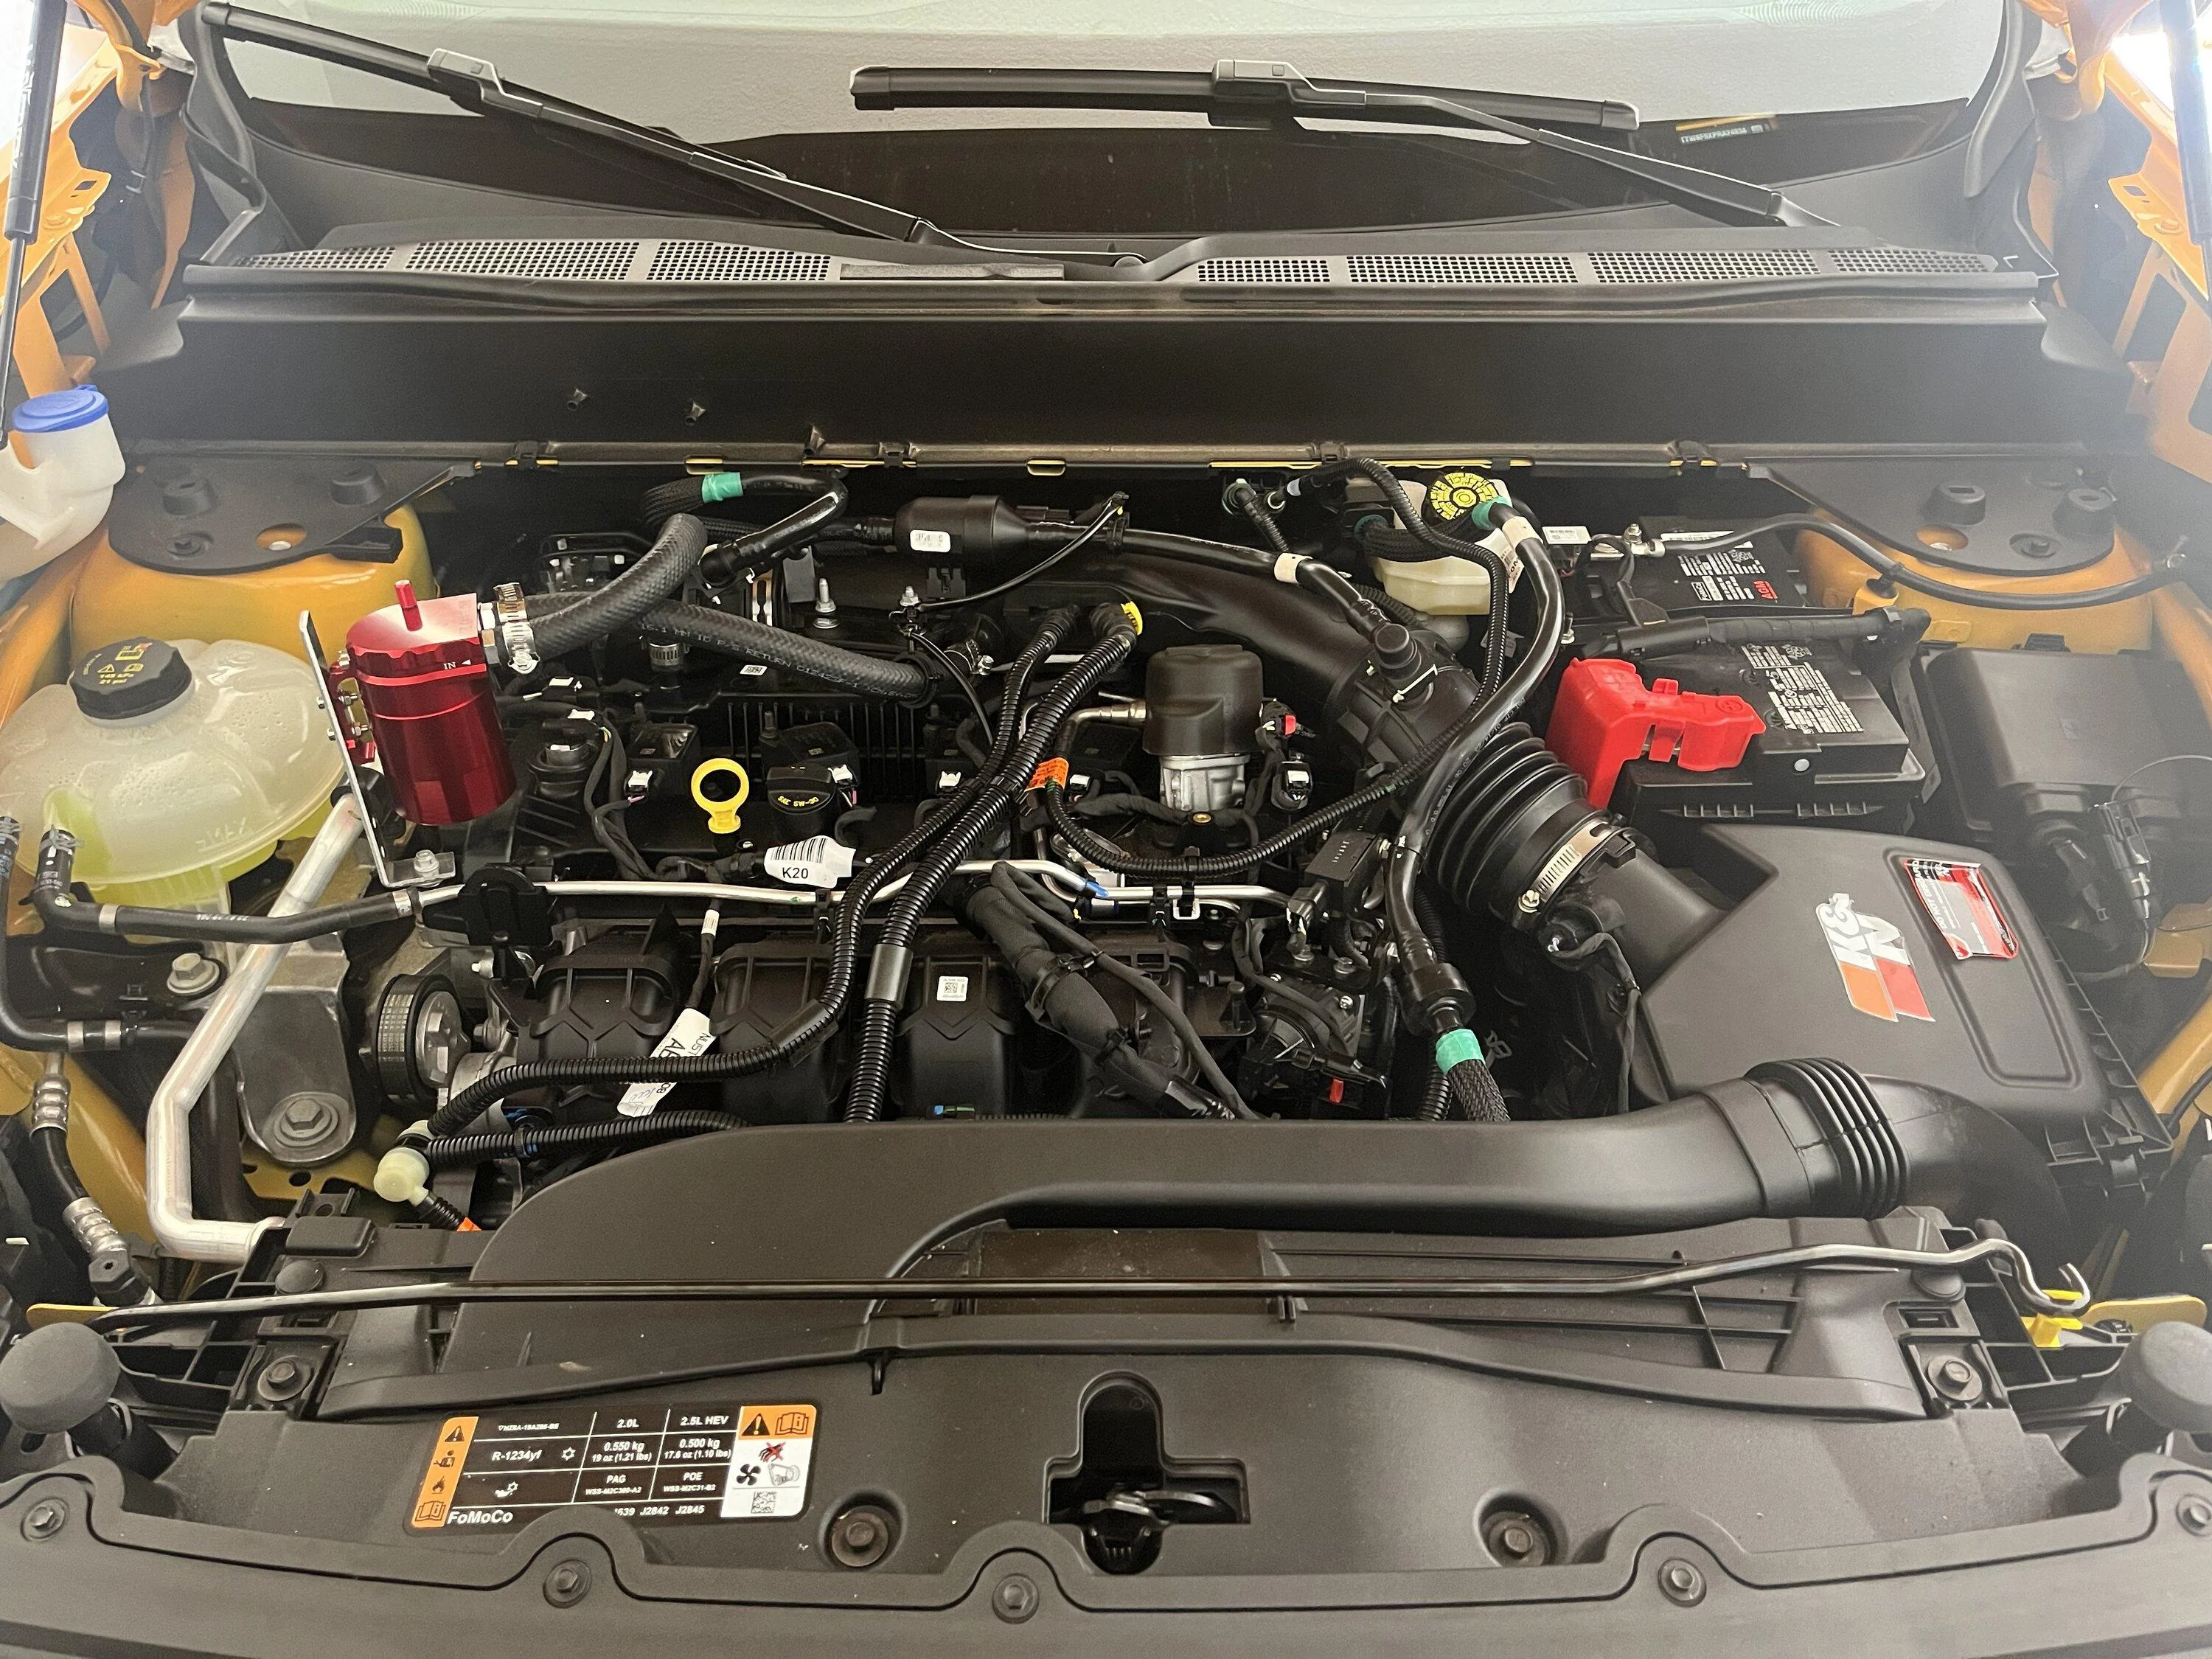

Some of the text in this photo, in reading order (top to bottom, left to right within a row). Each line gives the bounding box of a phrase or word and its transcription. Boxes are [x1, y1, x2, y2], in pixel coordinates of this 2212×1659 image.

[443, 661, 456, 670] IN
[782, 867, 808, 879] K20
[617, 1419, 639, 1429] 2.0L
[680, 1416, 729, 1426] 2.5L HEV
[604, 1441, 645, 1453] 0.550 kg
[679, 1438, 721, 1450] 0.500 kg
[492, 1449, 543, 1462] R-1234yf
[592, 1453, 602, 1462] 19
[614, 1453, 635, 1463] (1.21
[636, 1452, 653, 1462] lbs)
[664, 1449, 731, 1460] 17.6 oz (1.10 lbs)
[606, 1475, 627, 1484] PAG
[684, 1472, 703, 1481] POE
[640, 1506, 669, 1516] J2842
[675, 1505, 705, 1515] J2845
[447, 1510, 514, 1525] FoMoCo
